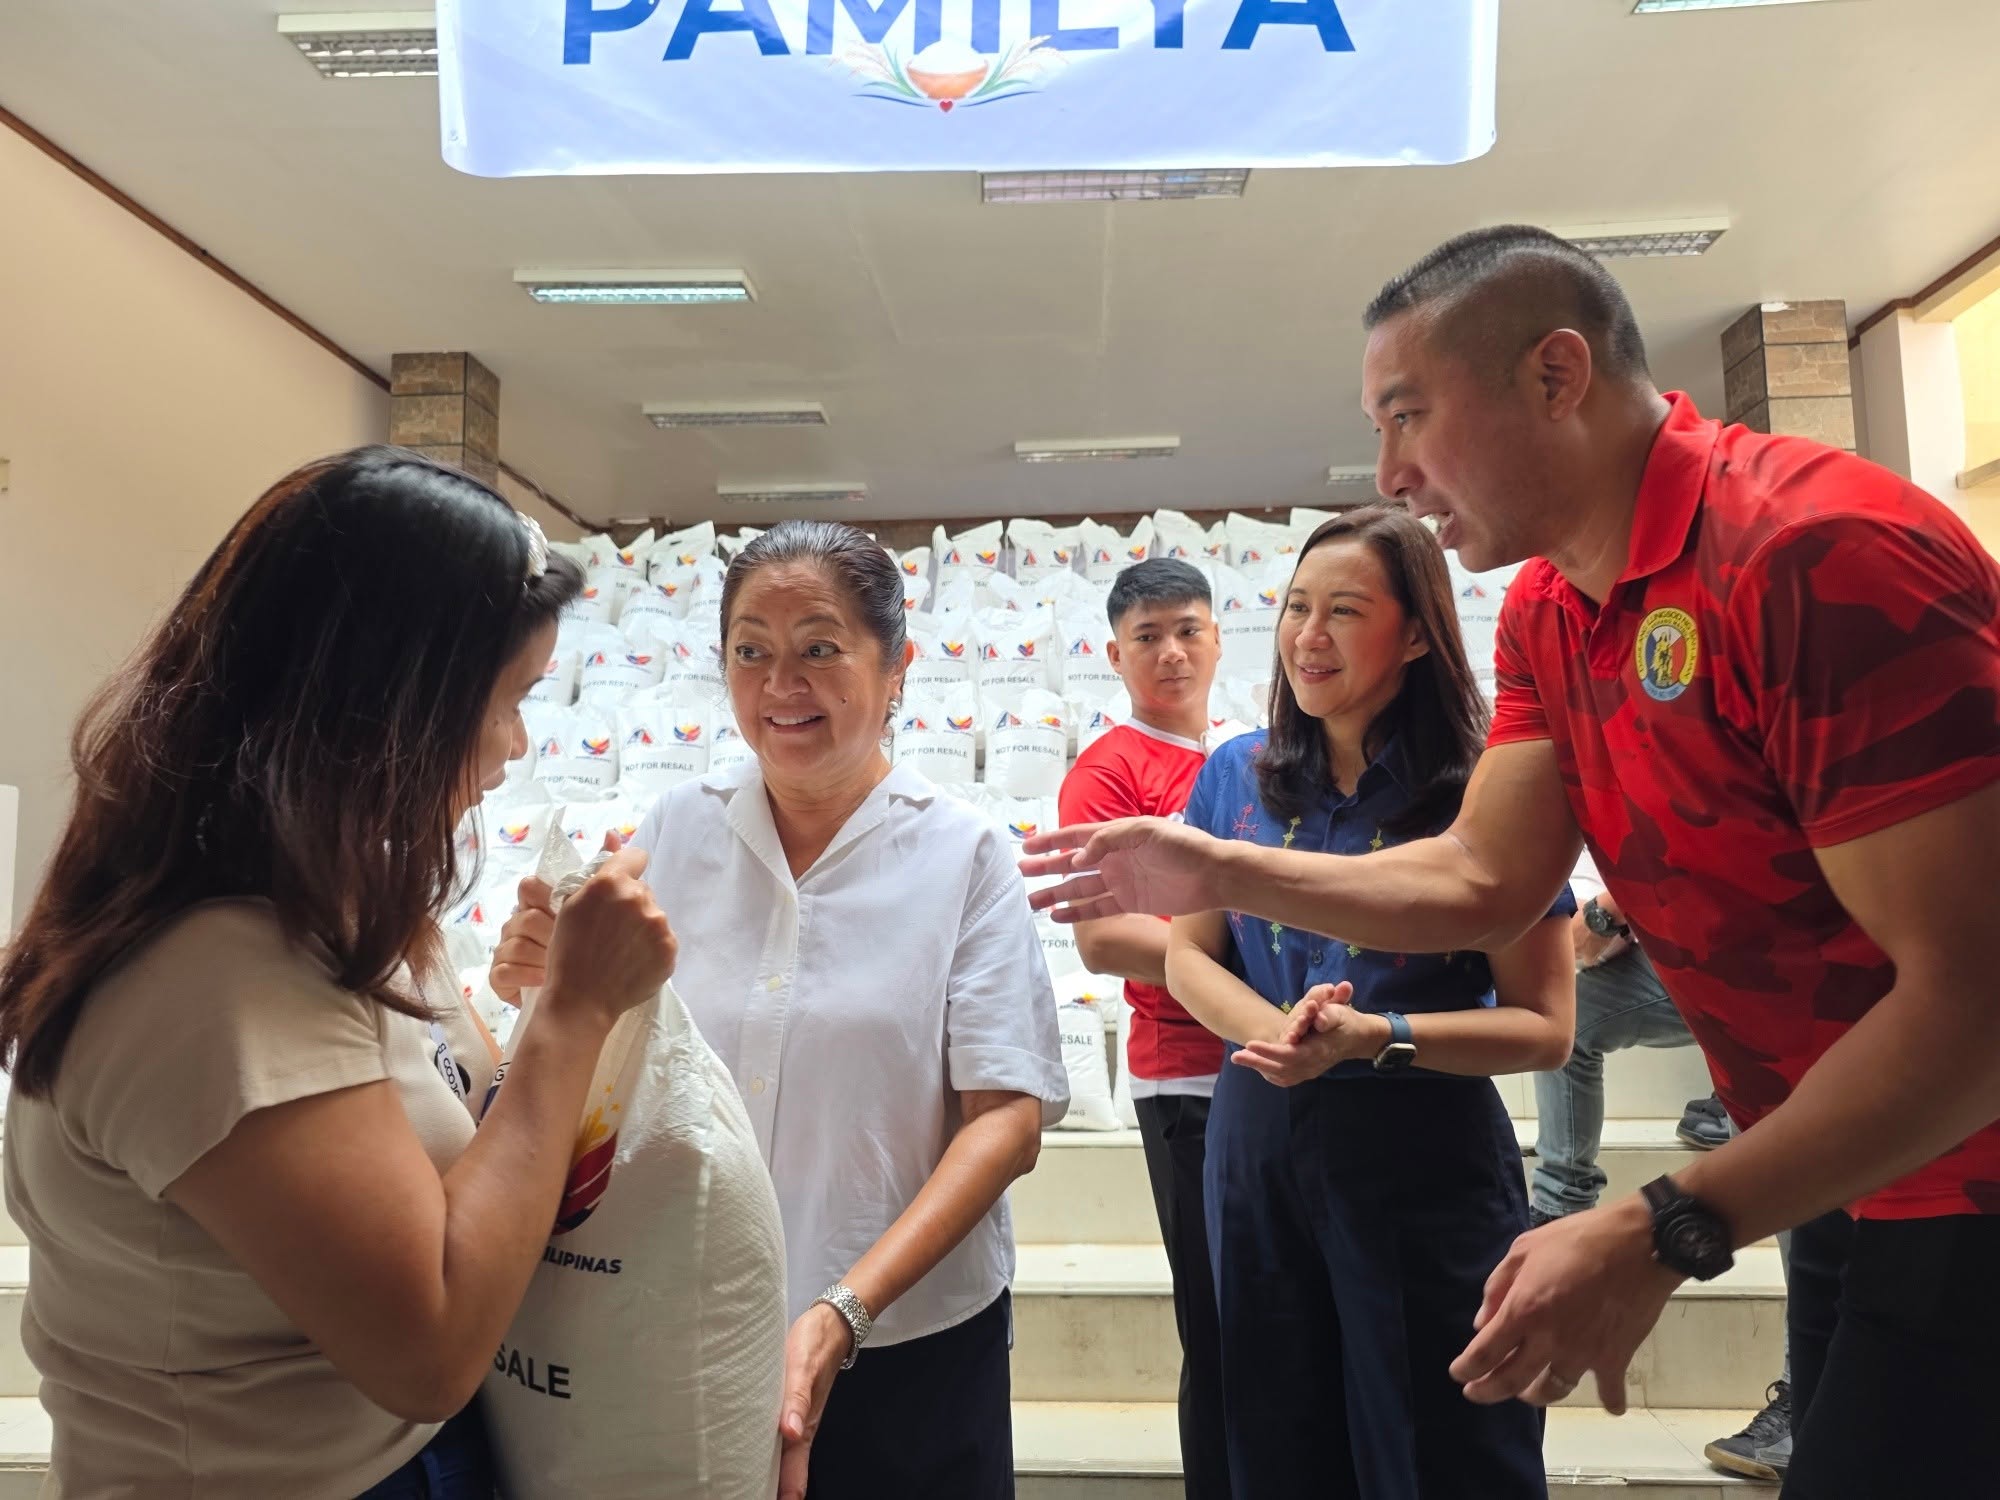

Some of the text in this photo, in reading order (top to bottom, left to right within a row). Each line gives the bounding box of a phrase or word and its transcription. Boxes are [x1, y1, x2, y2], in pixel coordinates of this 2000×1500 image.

[563, 0, 1356, 64] PAMILYA
[641, 761, 658, 770] FOR
[661, 761, 694, 772] RESALE
[1048, 939, 1069, 948] FOR
[1060, 1033, 1093, 1045] ESALE
[543, 1246, 622, 1274] ILIPINAS
[494, 1342, 572, 1399] SALE
